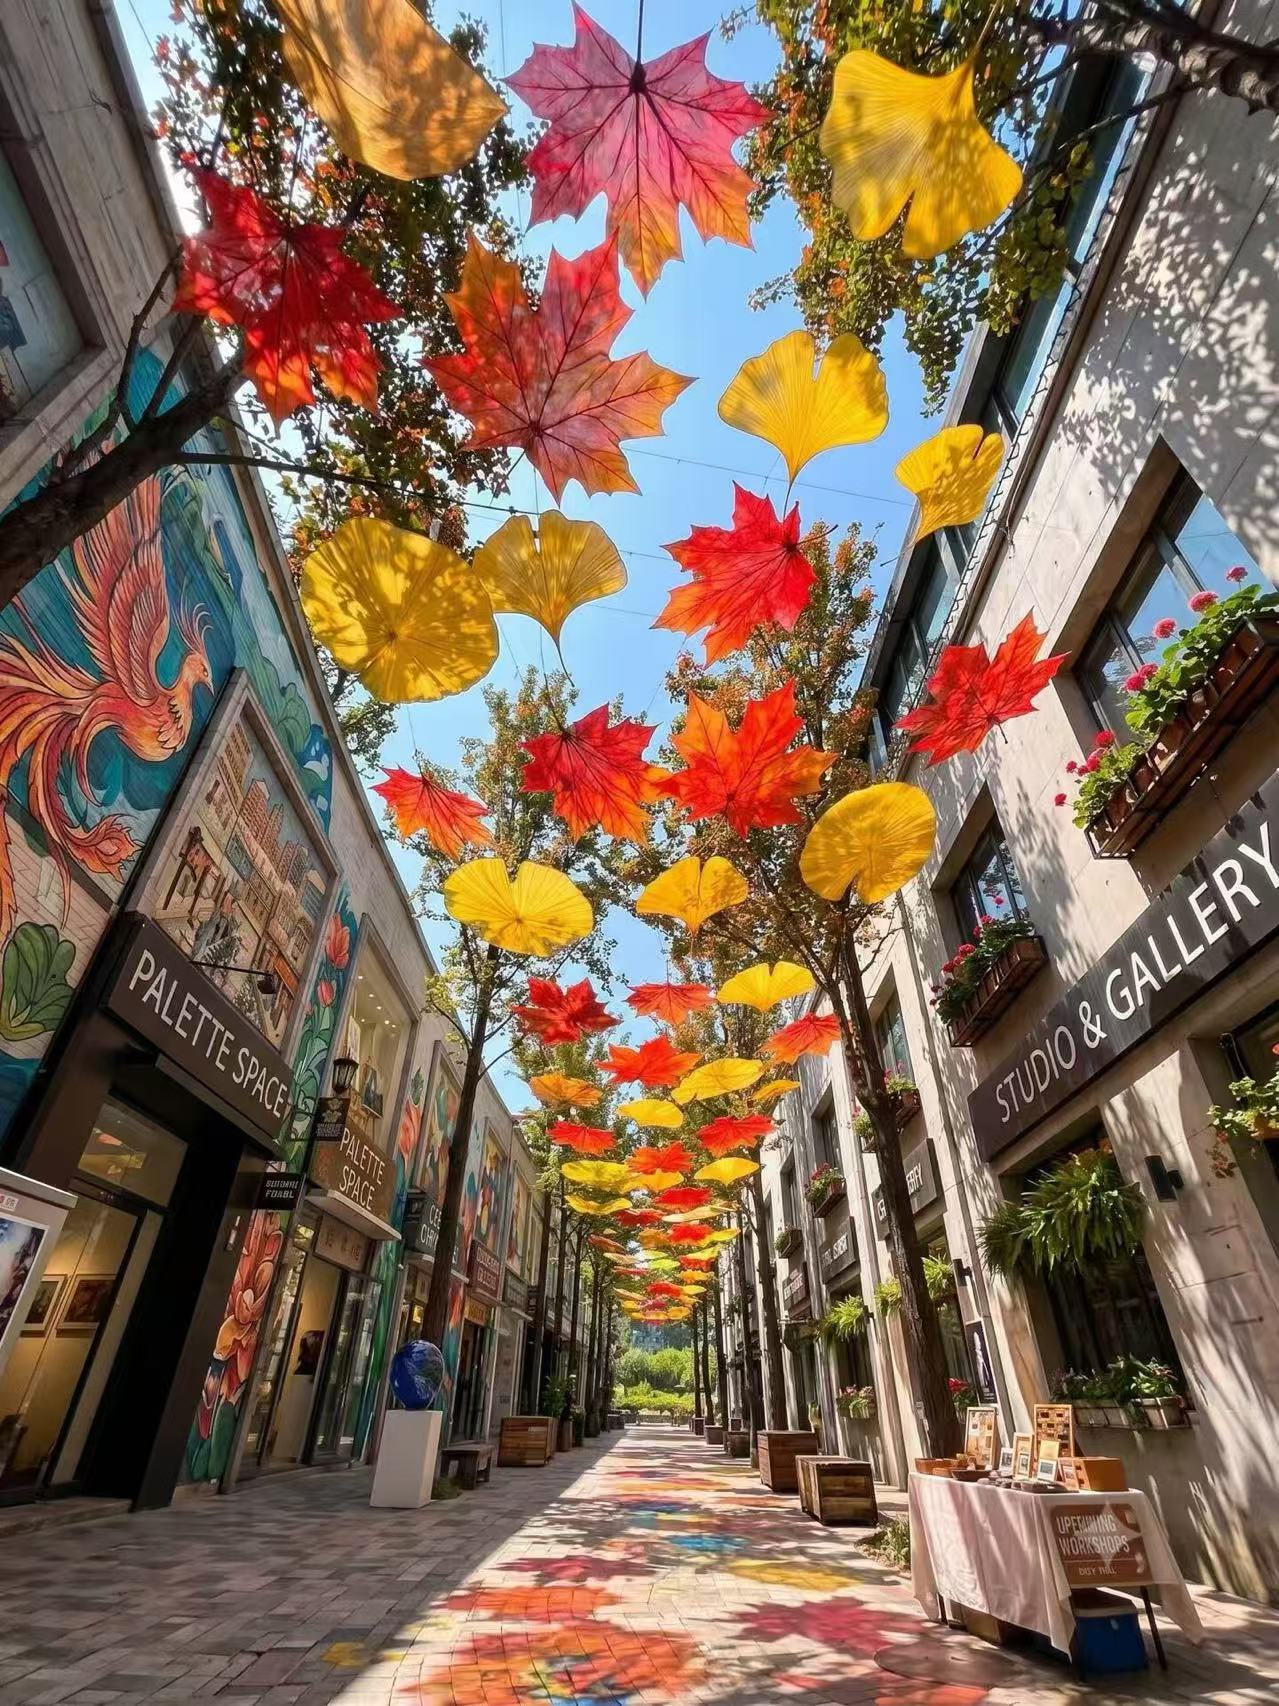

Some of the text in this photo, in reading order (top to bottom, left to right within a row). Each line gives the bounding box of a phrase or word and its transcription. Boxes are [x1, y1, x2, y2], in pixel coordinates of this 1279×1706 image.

[995, 820, 1279, 1124] STUDIO & GALLERY
[128, 949, 290, 1119] PALETTE SPACE
[339, 1127, 386, 1185] PALETTE
[339, 1165, 376, 1211] SPACE
[1058, 1535, 1130, 1556] WORKSHOPS
